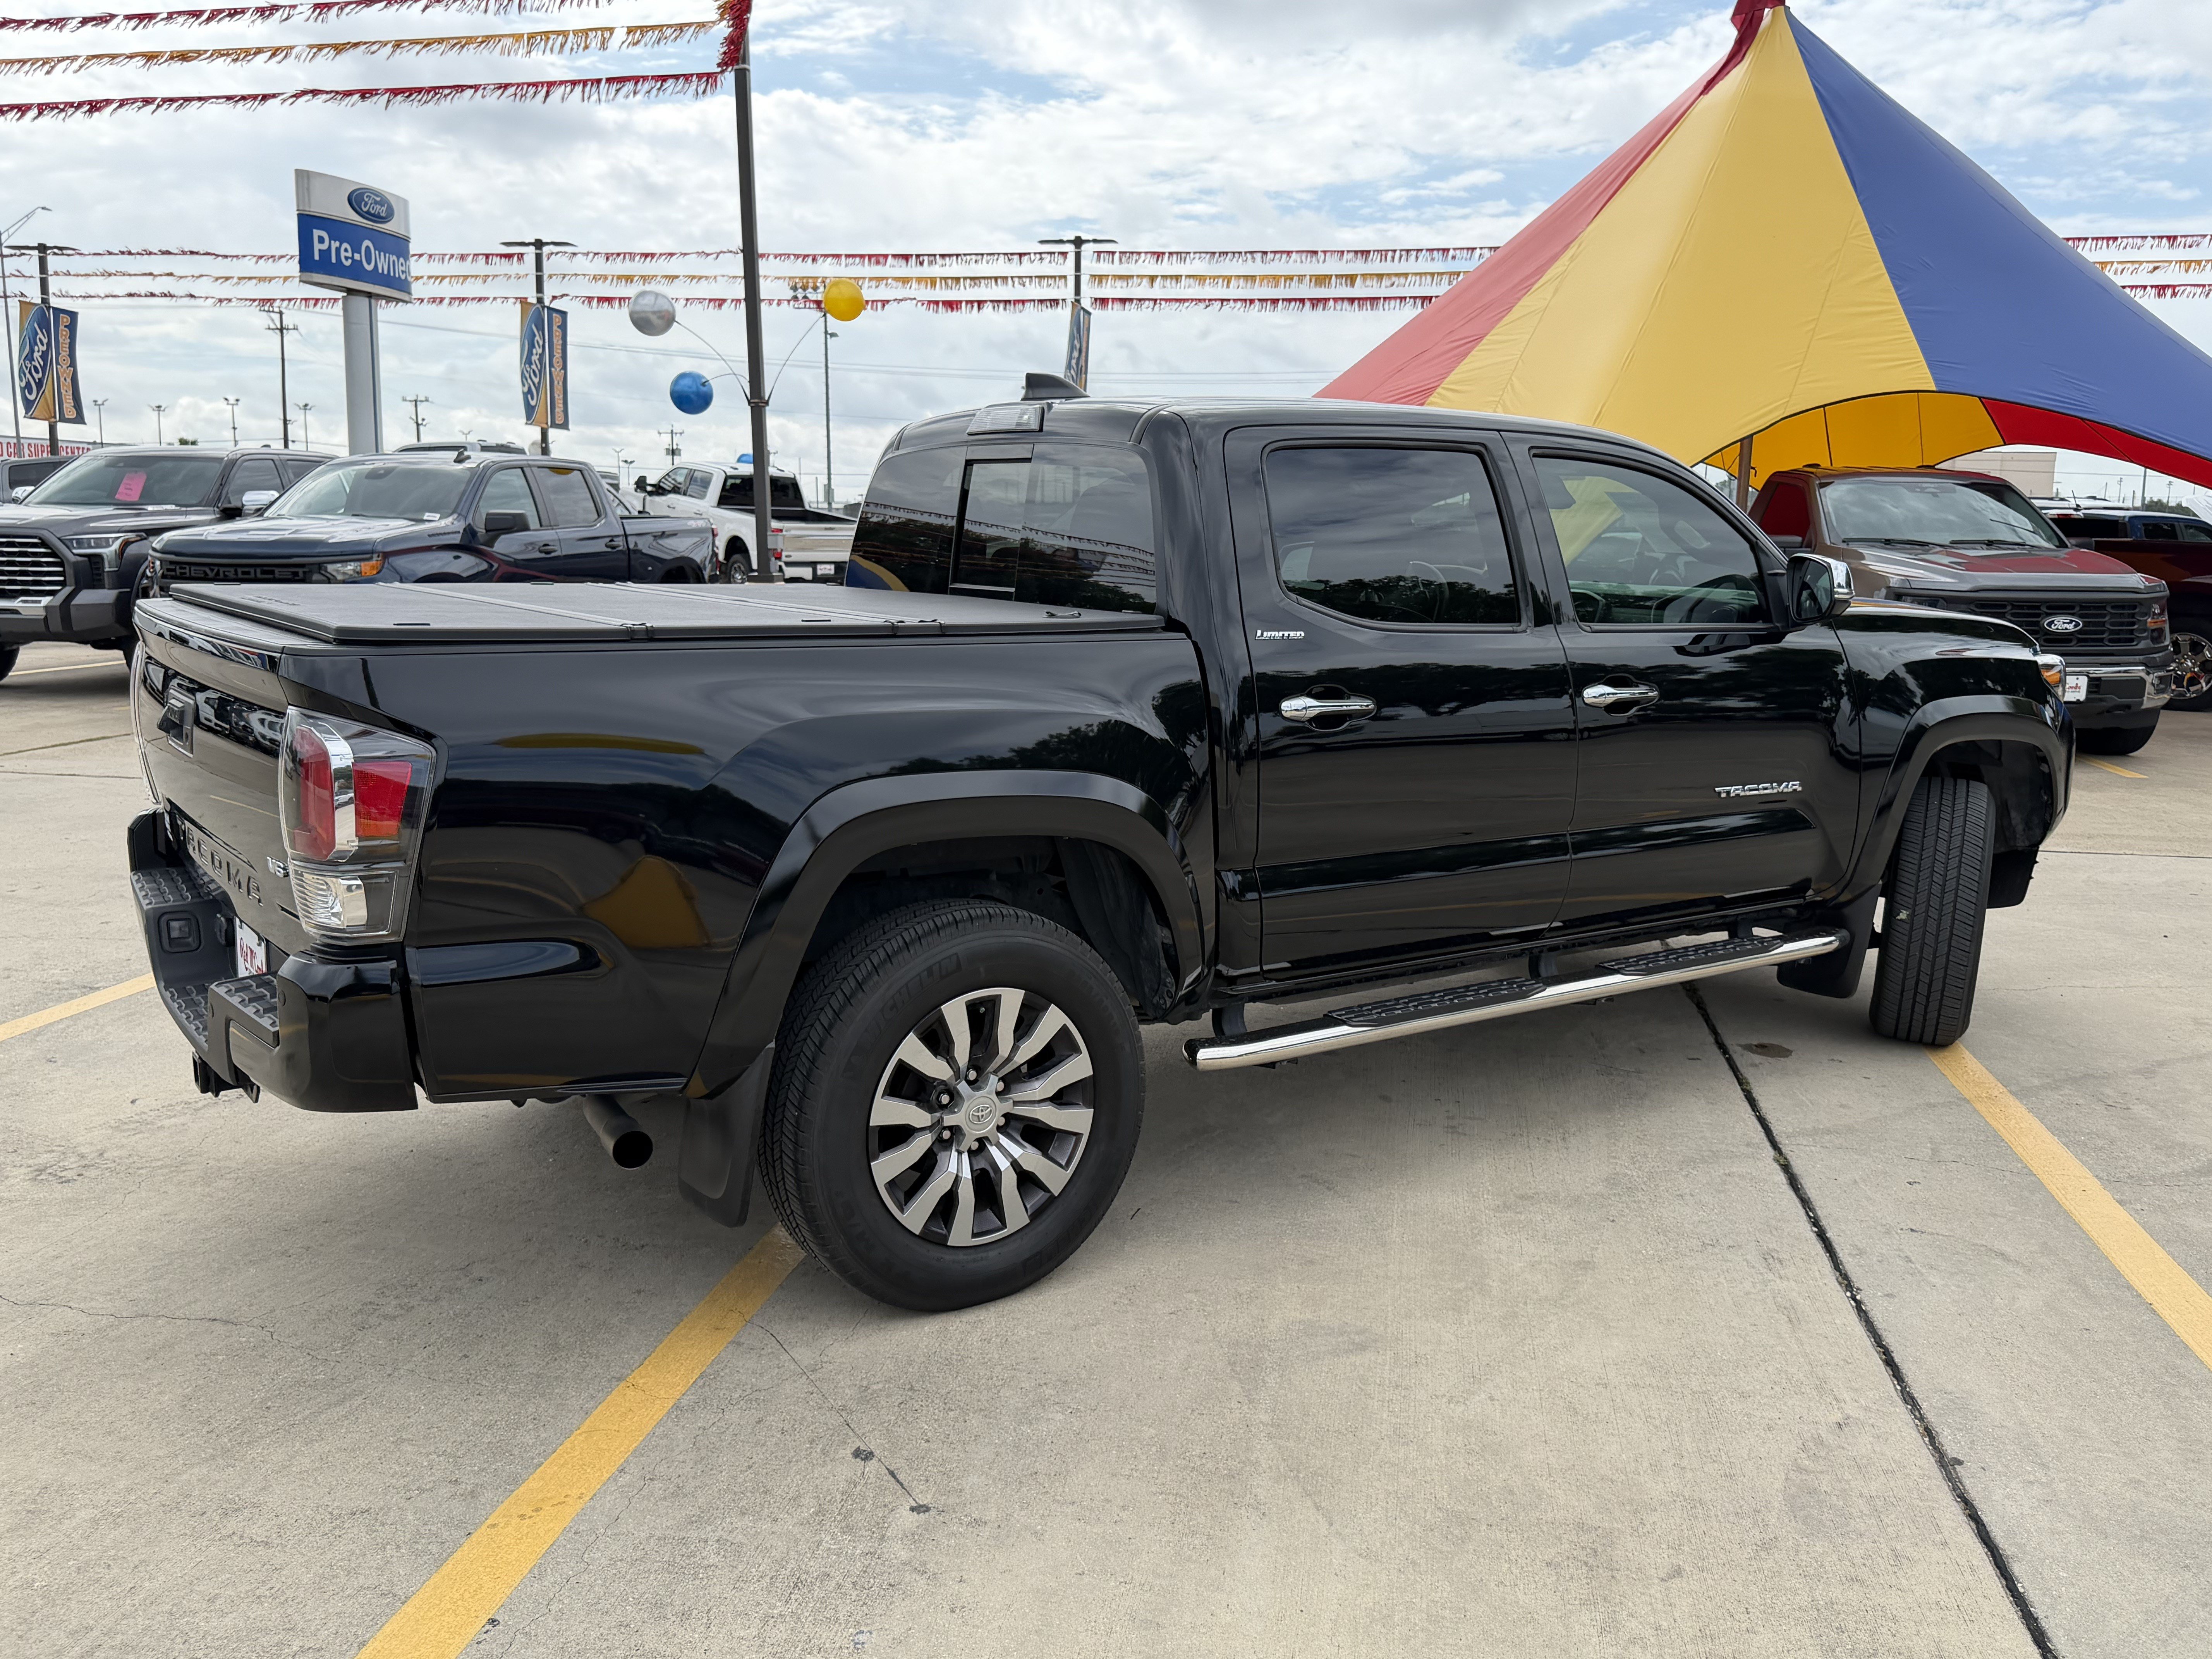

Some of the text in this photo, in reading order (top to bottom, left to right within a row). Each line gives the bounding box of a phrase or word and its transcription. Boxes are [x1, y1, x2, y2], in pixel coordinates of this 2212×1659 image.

[362, 193, 386, 216] Ford
[19, 321, 48, 400] Ford
[522, 323, 543, 406] Ford
[162, 565, 309, 579] CHEVROLET
[2051, 619, 2075, 629] Ford
[1714, 781, 1802, 798] TACOMA
